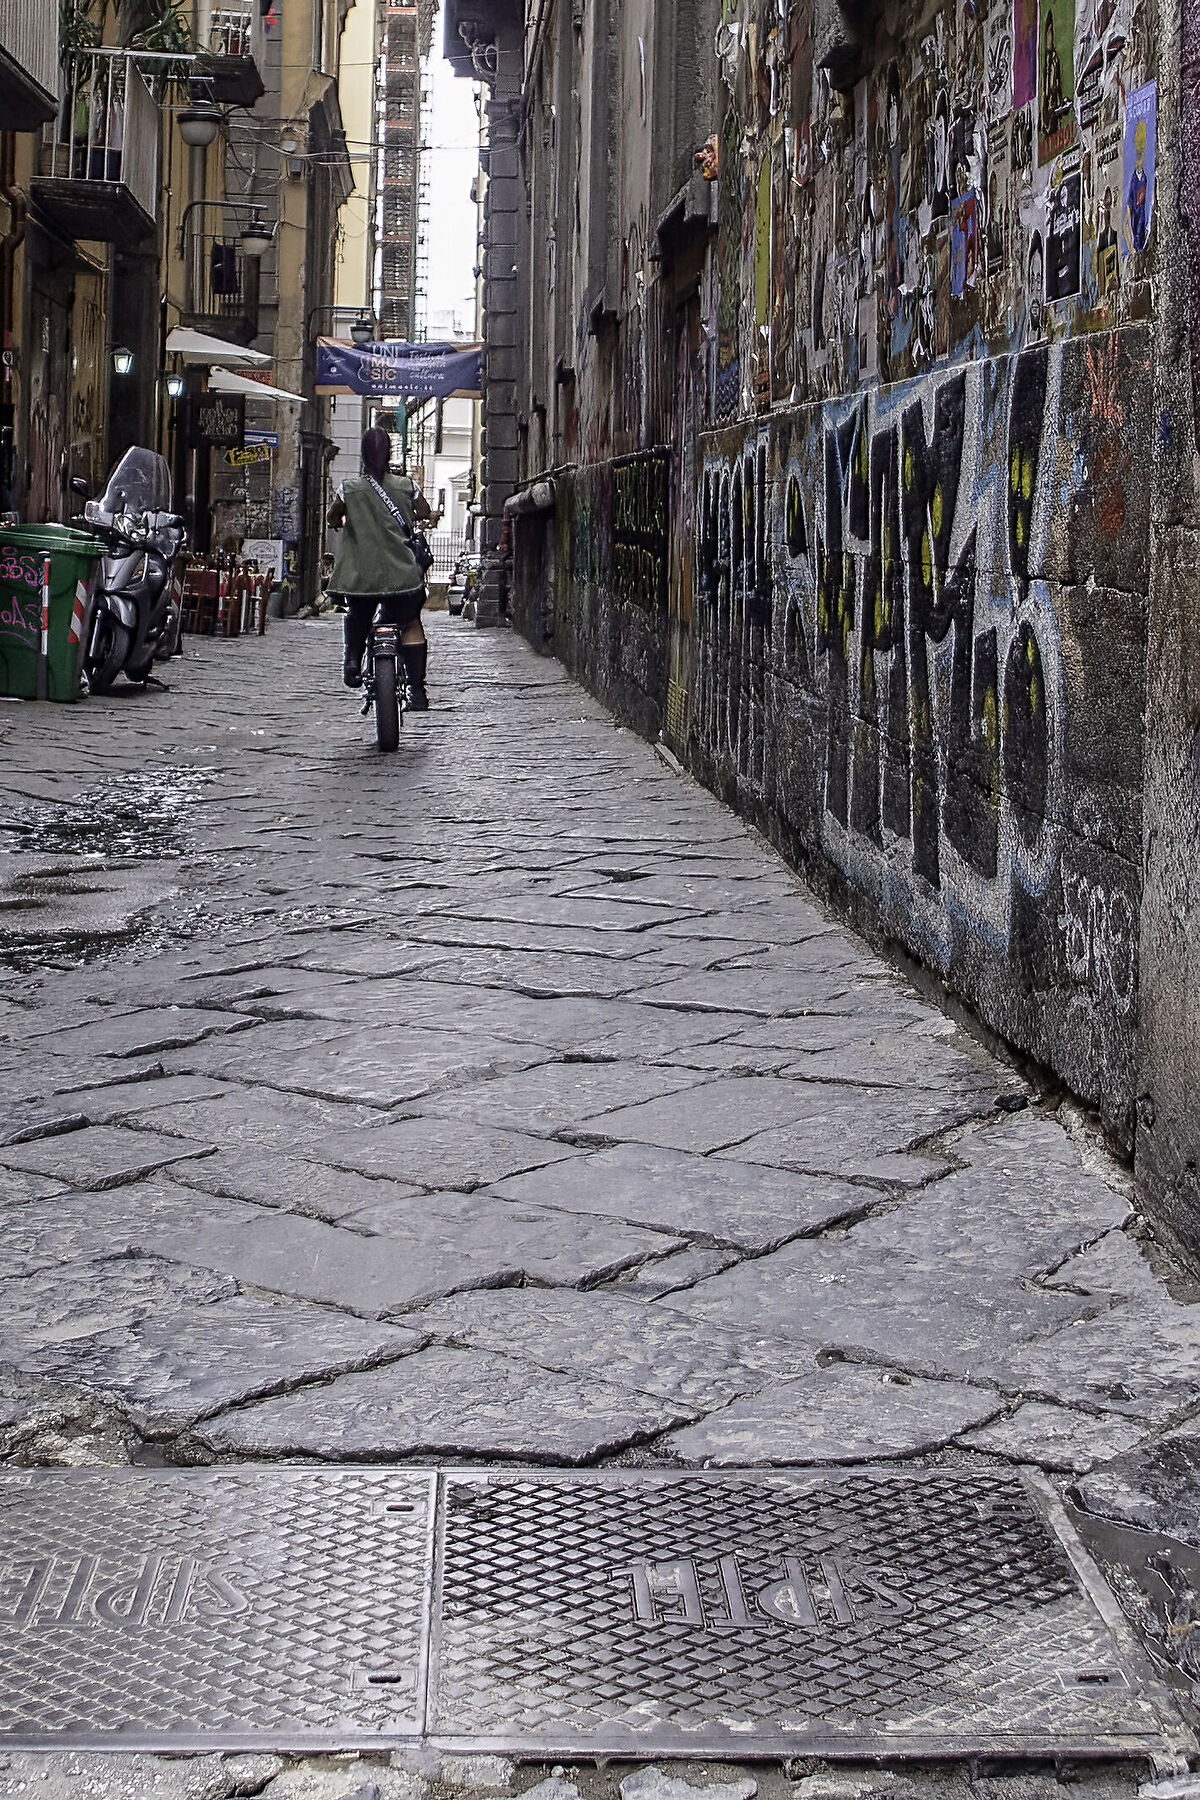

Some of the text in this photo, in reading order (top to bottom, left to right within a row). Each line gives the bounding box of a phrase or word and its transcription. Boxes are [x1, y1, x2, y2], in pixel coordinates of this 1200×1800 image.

[371, 344, 399, 358] UNI
[370, 357, 397, 368] MU
[370, 368, 397, 381] SIC
[611, 1556, 915, 1629] SIPTEL
